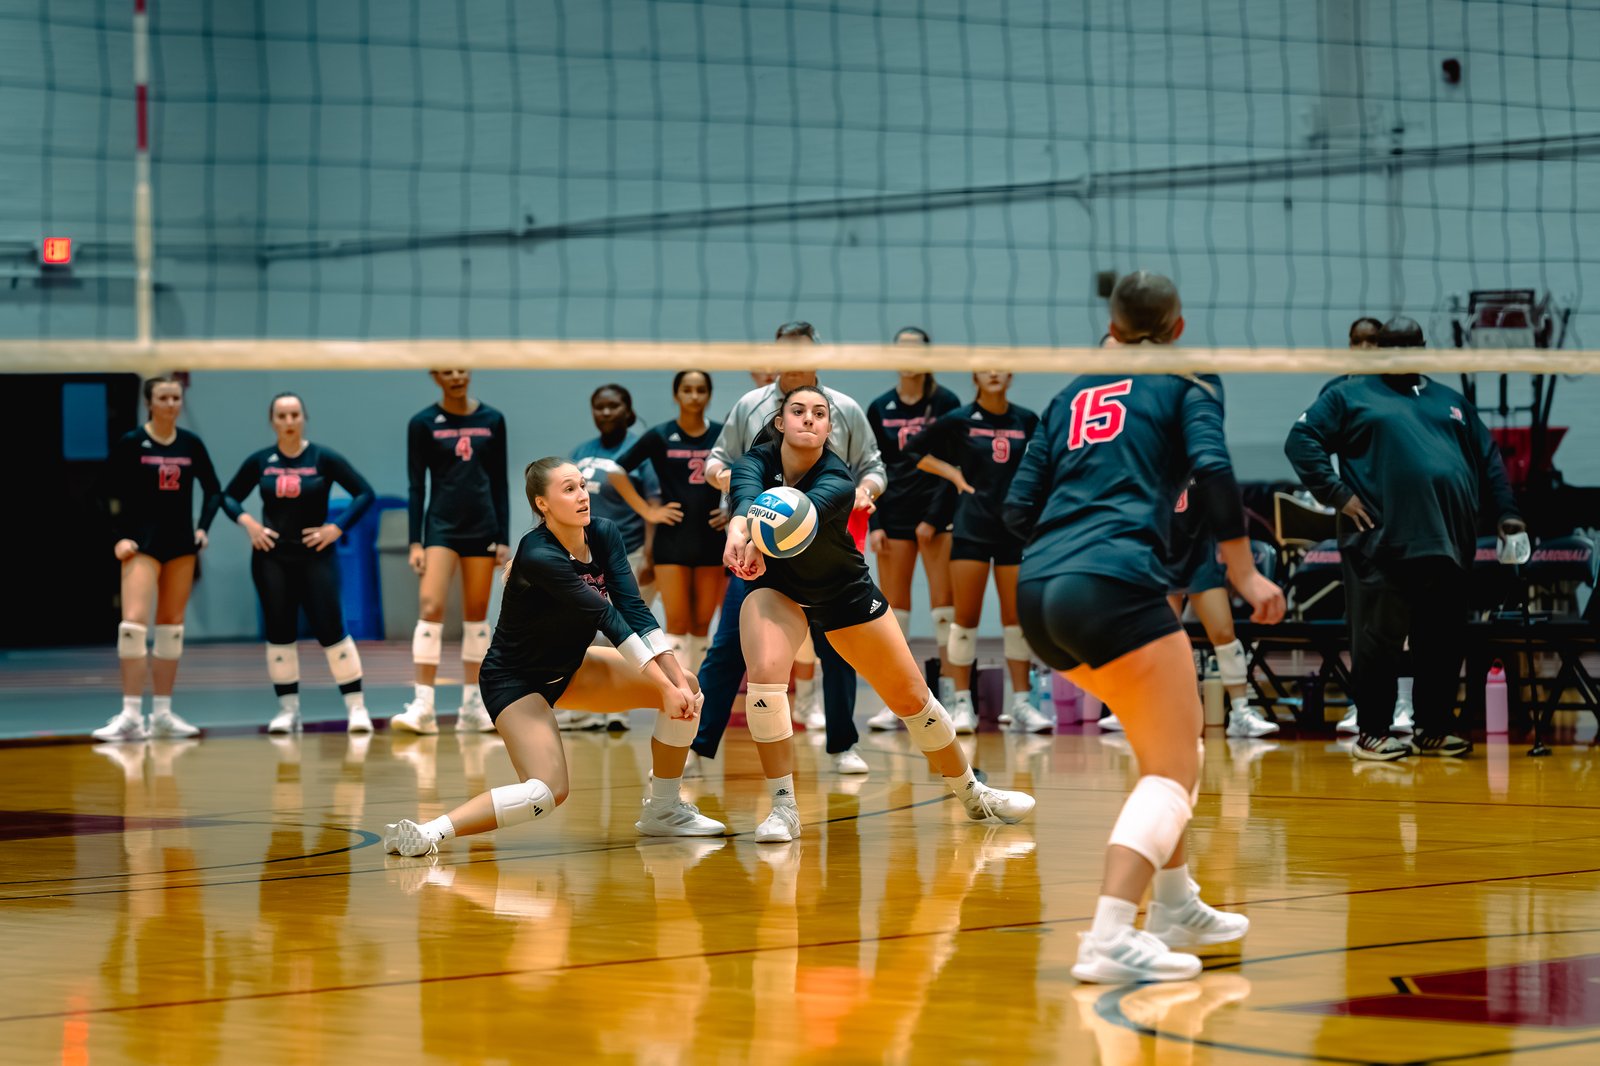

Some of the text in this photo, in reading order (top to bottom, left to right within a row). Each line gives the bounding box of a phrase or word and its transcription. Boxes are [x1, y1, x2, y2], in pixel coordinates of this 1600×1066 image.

[1067, 379, 1133, 450] 15
[455, 435, 473, 461] 4
[992, 437, 1010, 463] 9
[159, 464, 181, 490] 12
